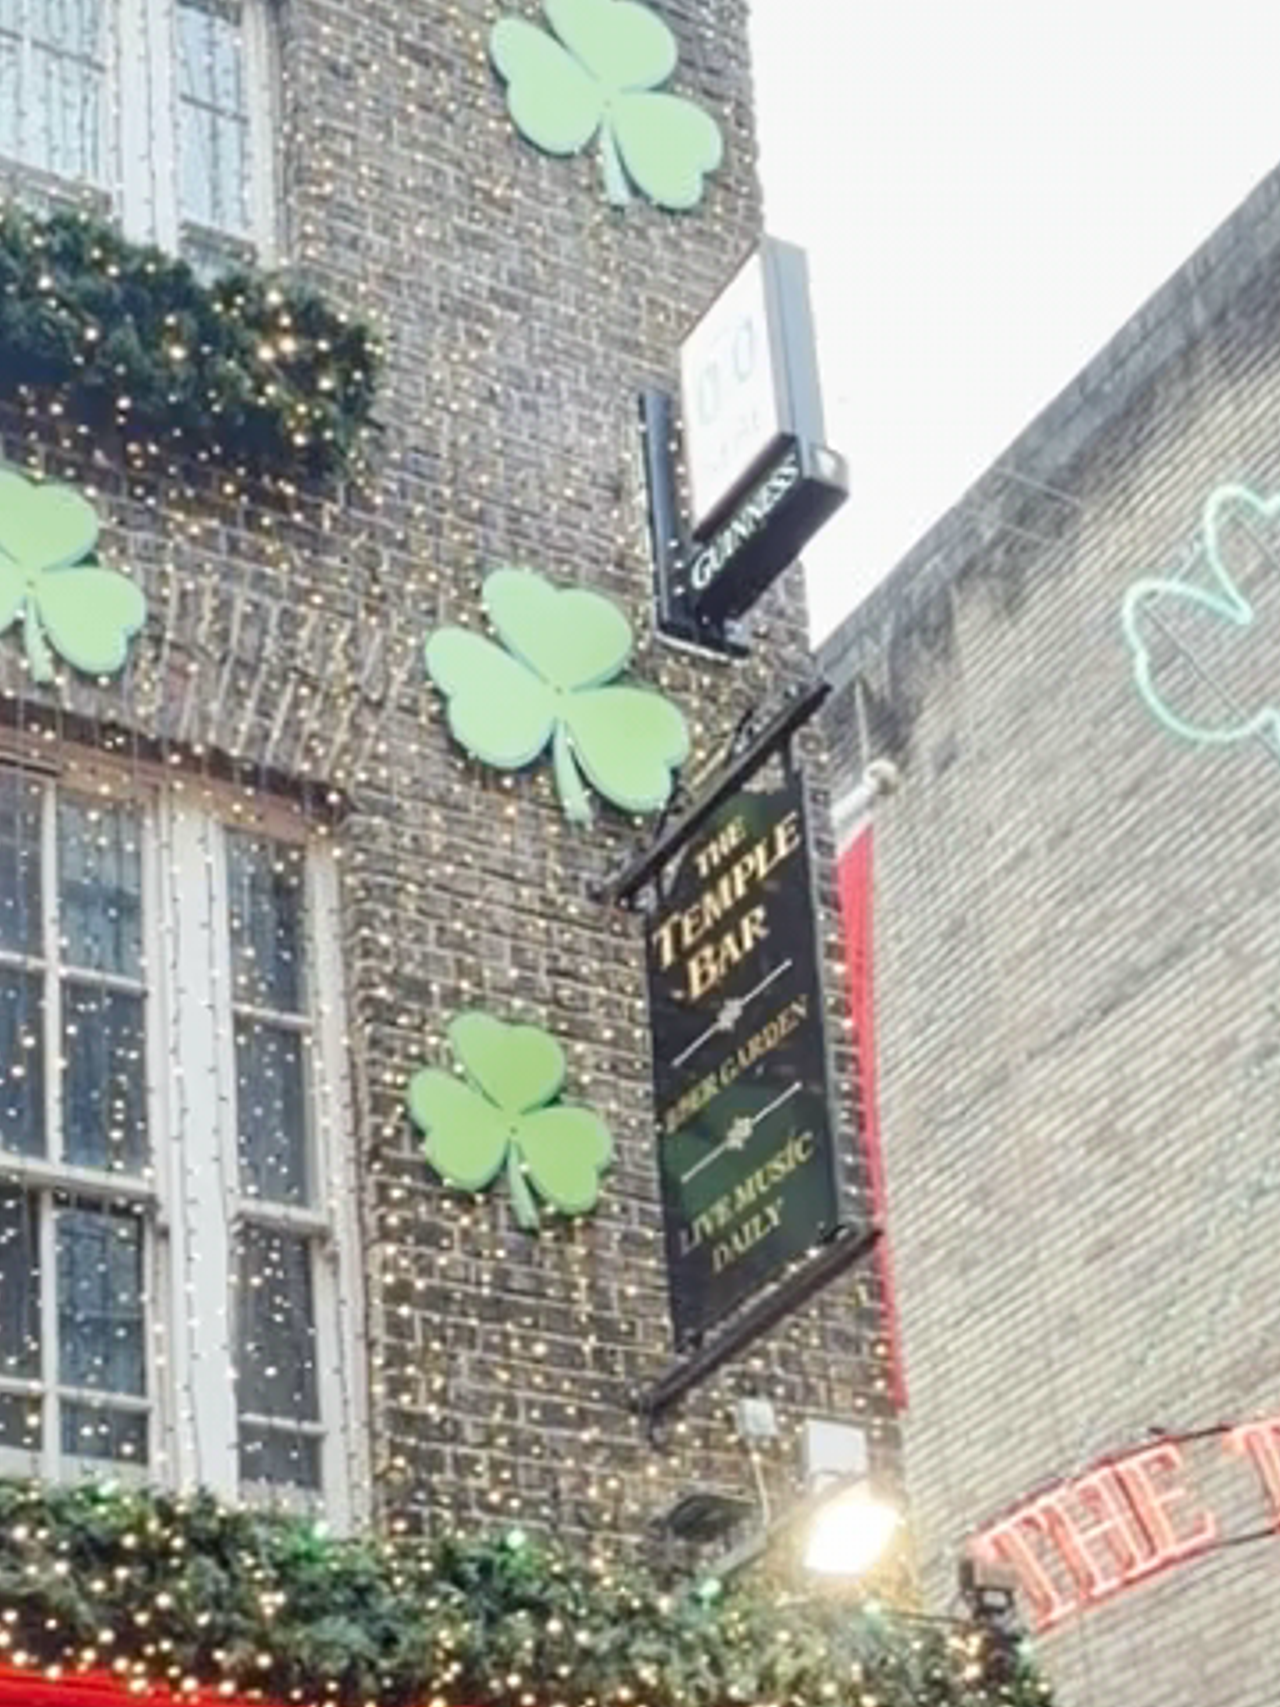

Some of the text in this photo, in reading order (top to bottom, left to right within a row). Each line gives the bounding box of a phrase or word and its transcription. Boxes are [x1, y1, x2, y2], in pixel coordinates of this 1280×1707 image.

[691, 449, 799, 590] GUINNESS
[652, 810, 801, 970] TEMPLE
[694, 815, 746, 878] THE
[686, 904, 770, 1003] BAR
[720, 994, 809, 1087] GARDEN
[678, 1130, 815, 1257] LIVE MUSIC
[712, 1197, 785, 1274] DAILY
[973, 1441, 1218, 1633] THE
